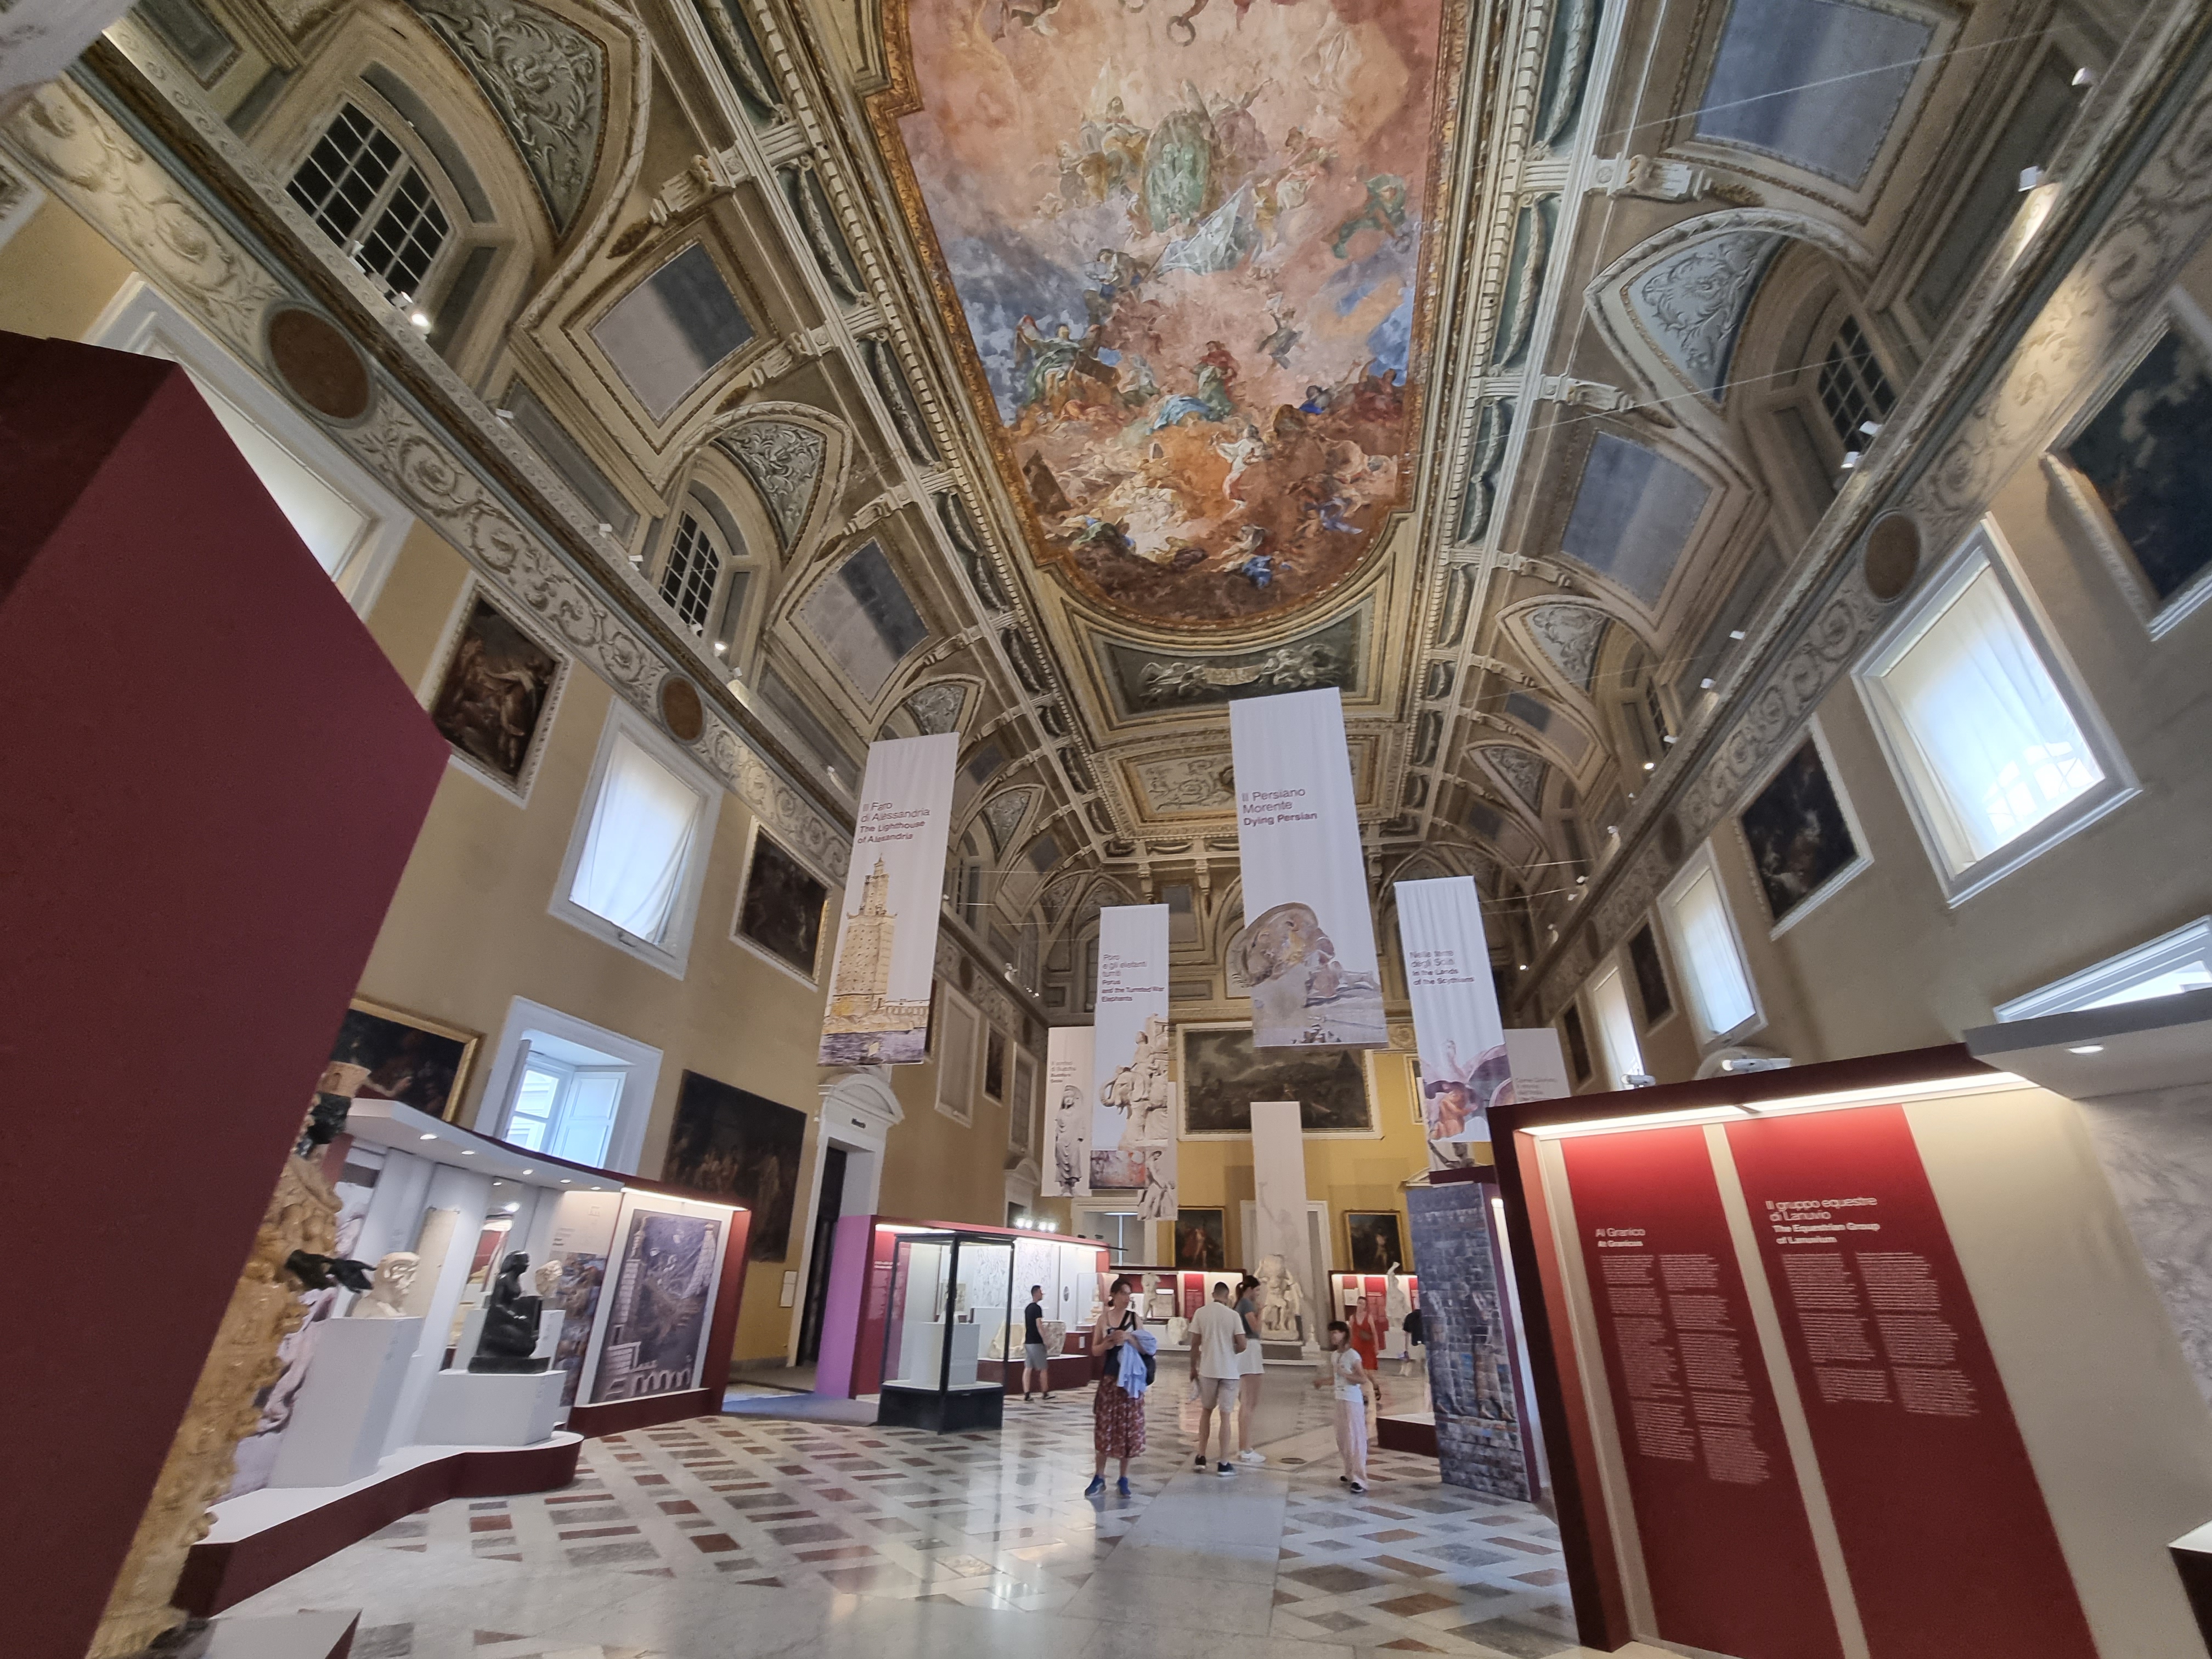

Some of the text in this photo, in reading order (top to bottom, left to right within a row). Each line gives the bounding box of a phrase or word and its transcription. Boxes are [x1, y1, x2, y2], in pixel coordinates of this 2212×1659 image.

[1242, 788, 1306, 802] Il Persiano
[871, 802, 893, 811] Faro
[1243, 800, 1293, 814] Morente
[861, 808, 930, 822] di Alessandria
[1243, 812, 1318, 827] Dying Persian
[878, 820, 926, 832] Lighthouse
[868, 832, 914, 843] Alexandria
[1775, 1200, 1821, 1212] gruppo
[1821, 1197, 1878, 1209] equestre
[1769, 1210, 1832, 1222] di Lanuvio
